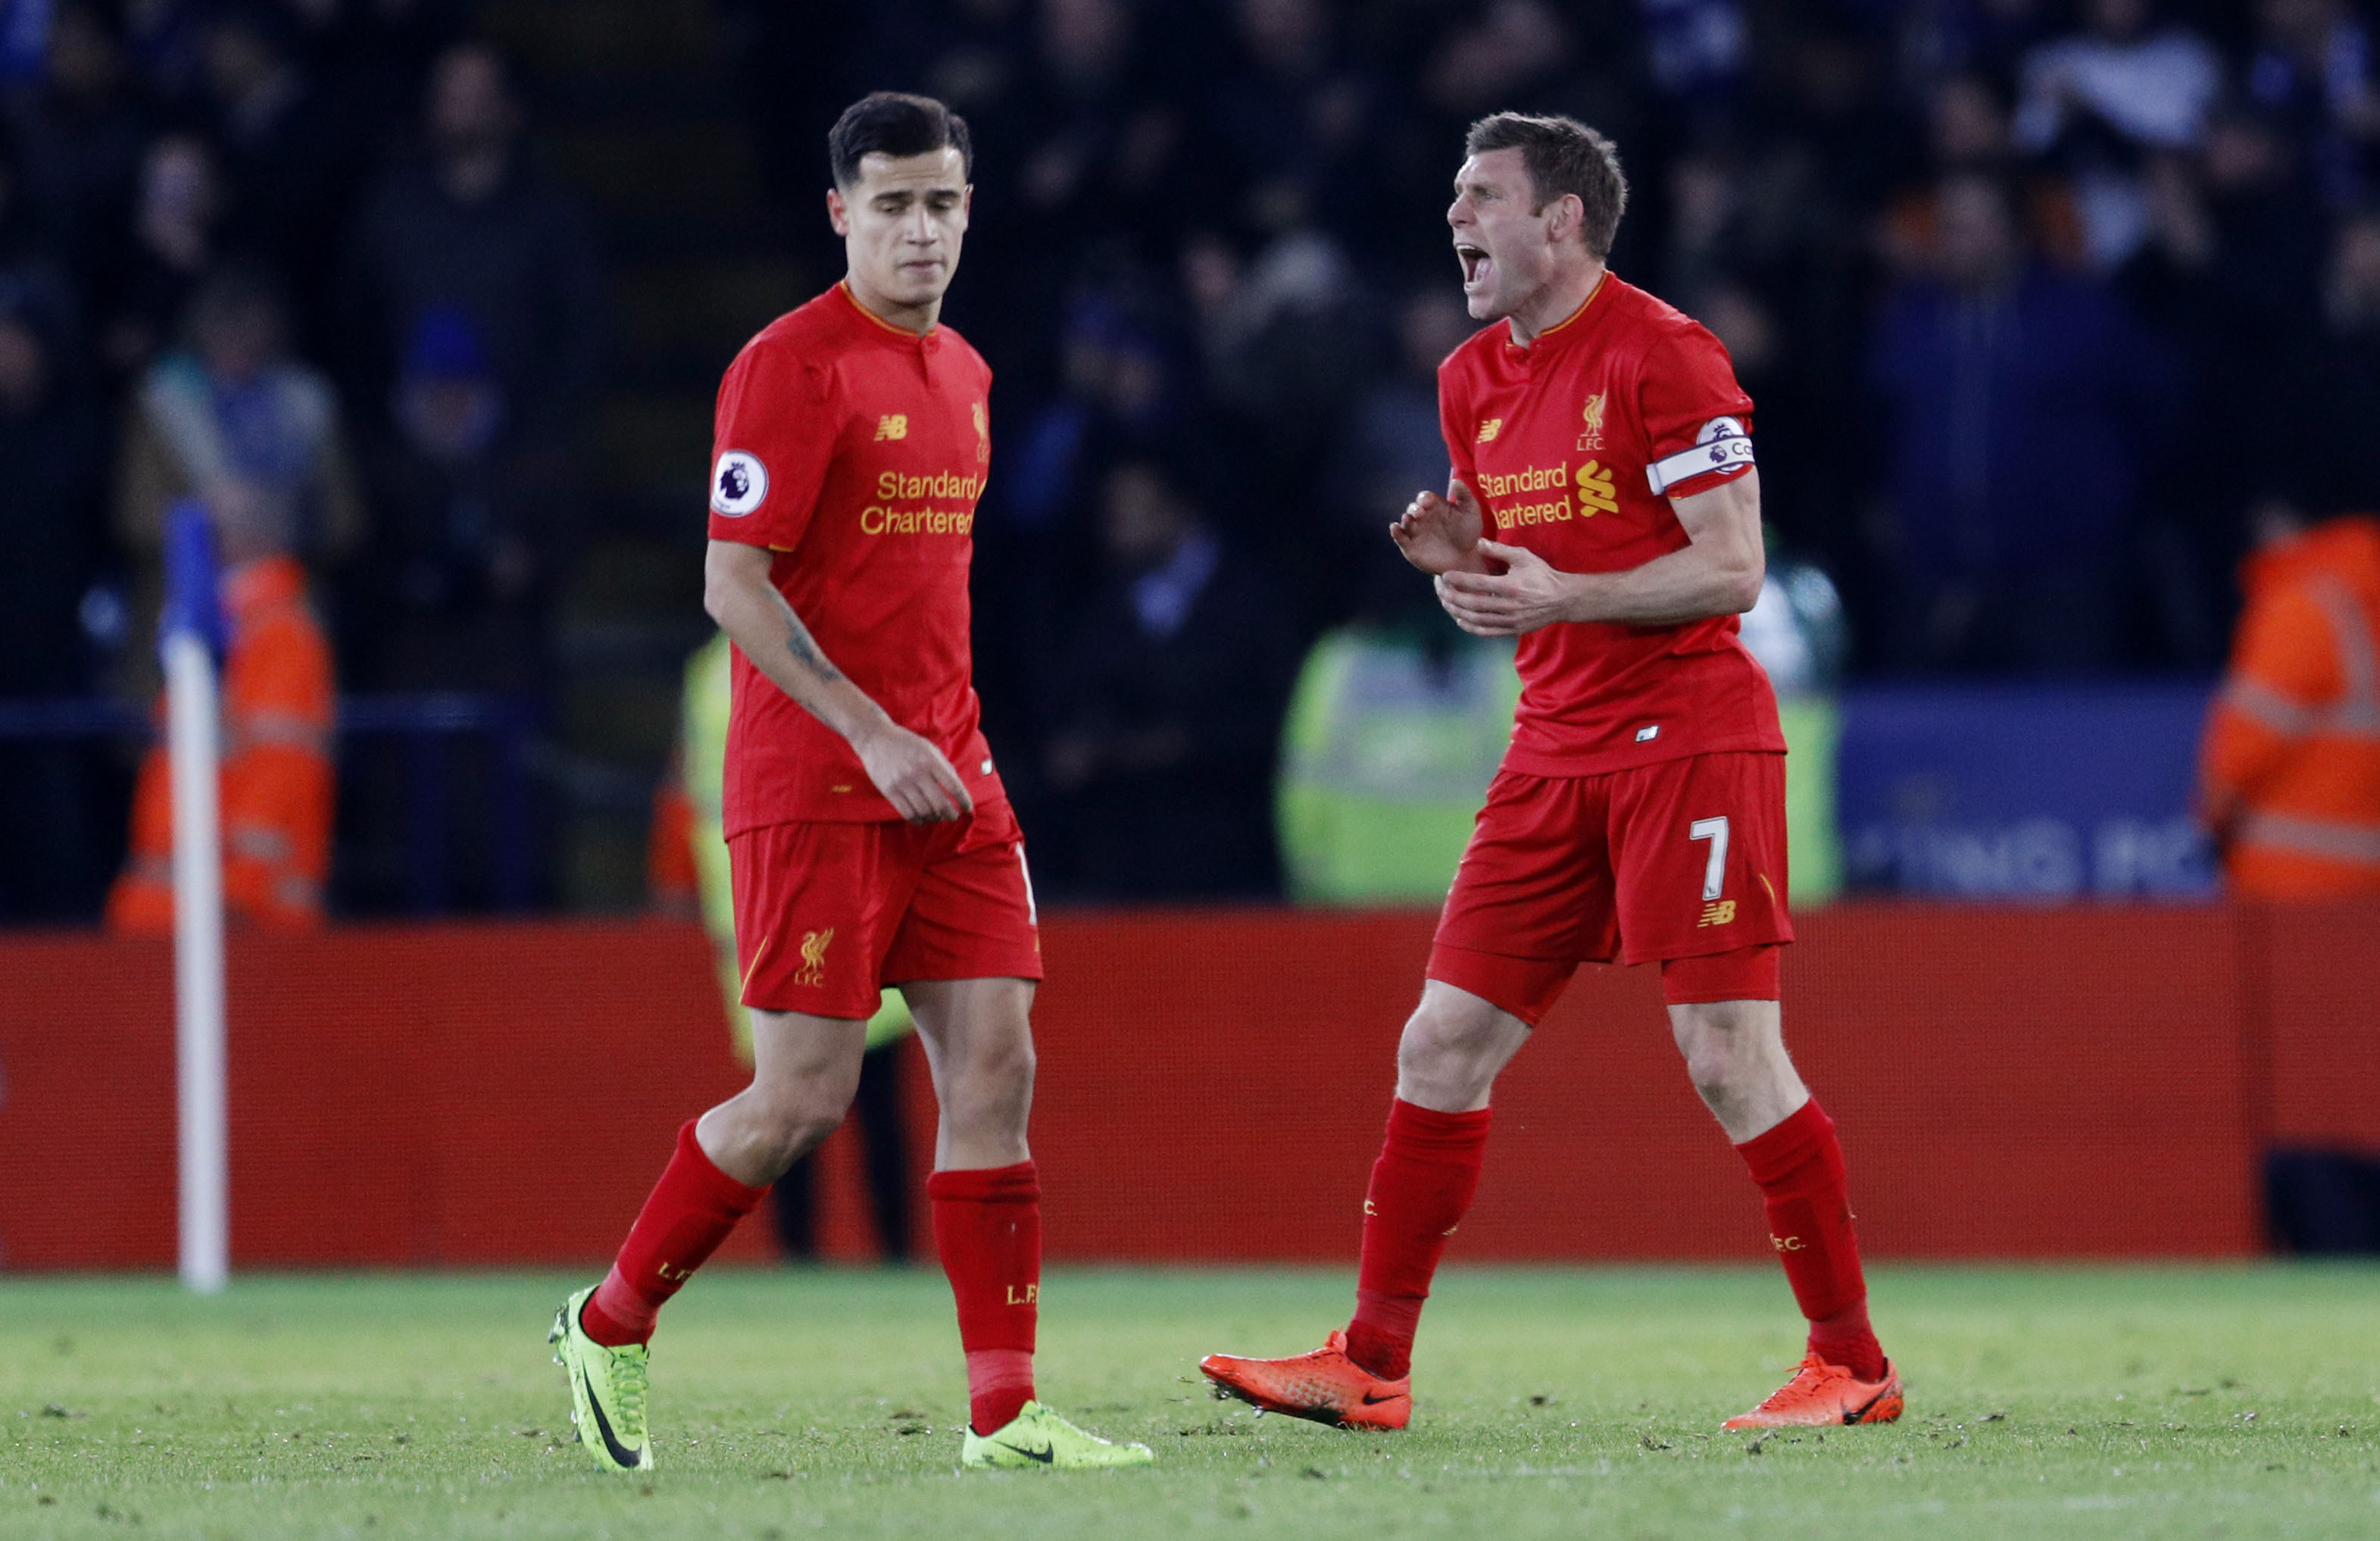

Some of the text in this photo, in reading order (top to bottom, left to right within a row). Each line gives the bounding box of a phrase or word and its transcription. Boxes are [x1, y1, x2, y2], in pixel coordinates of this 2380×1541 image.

[876, 469, 978, 500] Standard
[1478, 461, 1567, 498] Standard
[860, 506, 974, 535] Chartered
[1491, 495, 1573, 530] artered
[1690, 815, 1729, 902] 7
